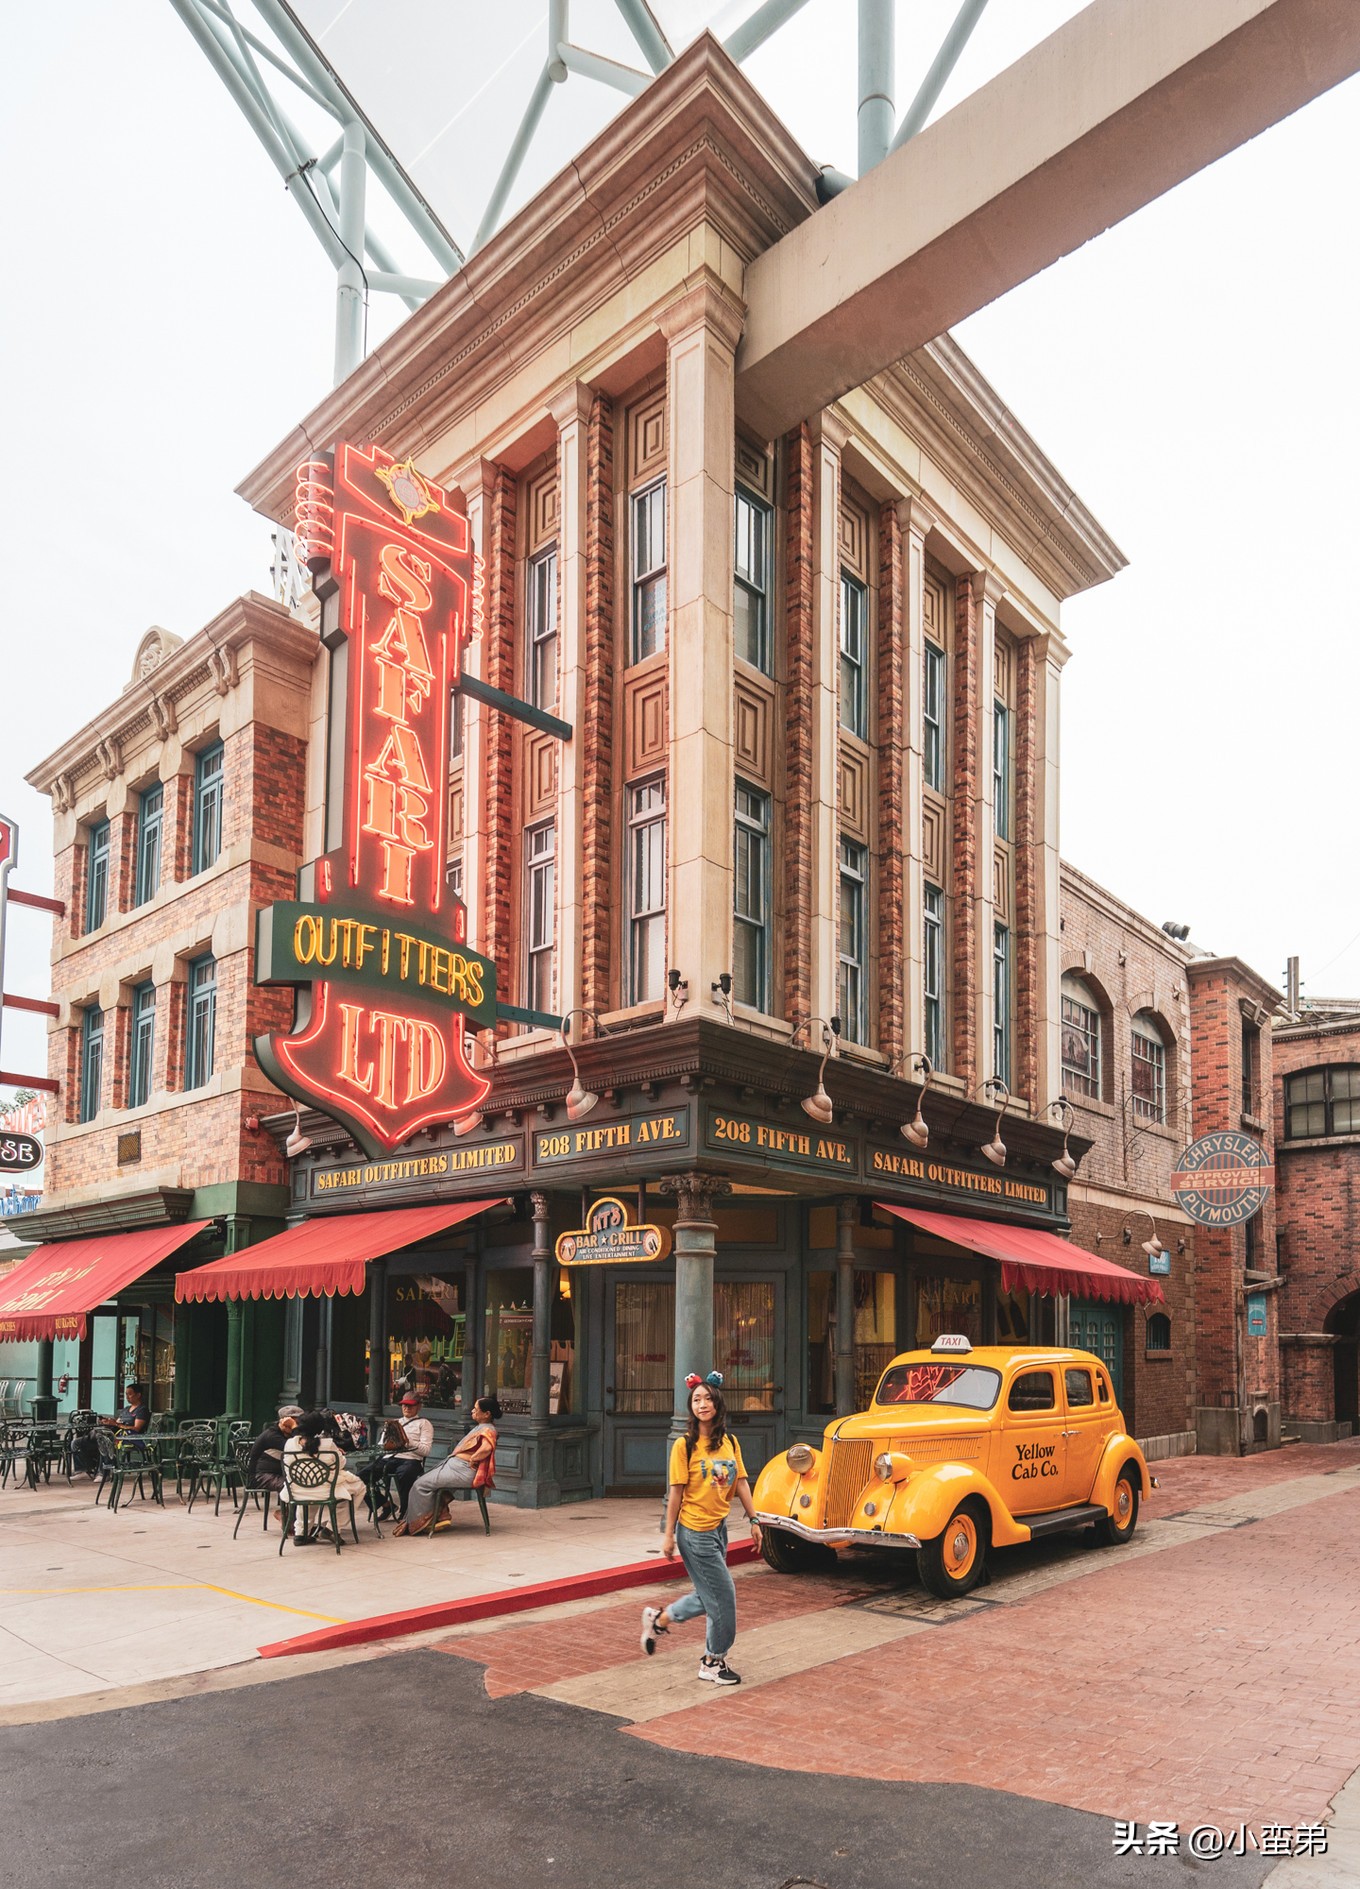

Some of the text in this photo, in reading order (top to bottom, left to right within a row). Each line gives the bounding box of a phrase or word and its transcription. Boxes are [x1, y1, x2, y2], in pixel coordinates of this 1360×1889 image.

[361, 543, 435, 905] SAFARI
[294, 914, 485, 1007] OUTFITTERS
[337, 1003, 447, 1111] LTD
[539, 1117, 682, 1158] 208 FIFTH AVE.
[714, 1117, 851, 1163] 208 FIFTH AVE.
[1183, 1136, 1262, 1169] CHRYSLER
[318, 1144, 517, 1191] SAFARI OUTFITTERS LIMITED
[873, 1151, 1047, 1203] SAFARI OUTFITTERS LIMITED
[1185, 1169, 1260, 1180] APPROVED
[1179, 1176, 1266, 1188] SERVICE
[1183, 1189, 1262, 1222] PLYMOUTH
[576, 1231, 643, 1249] BAR GRILL
[595, 1251, 635, 1259] ENTERTAINMENT
[395, 1284, 459, 1302] SAFARI
[921, 1288, 977, 1305] SAFARI
[55, 1316, 78, 1329] BURGERS
[941, 1337, 962, 1346] TAXI
[1015, 1443, 1056, 1461] Yellow
[1011, 1460, 1059, 1480] Cab Co.
